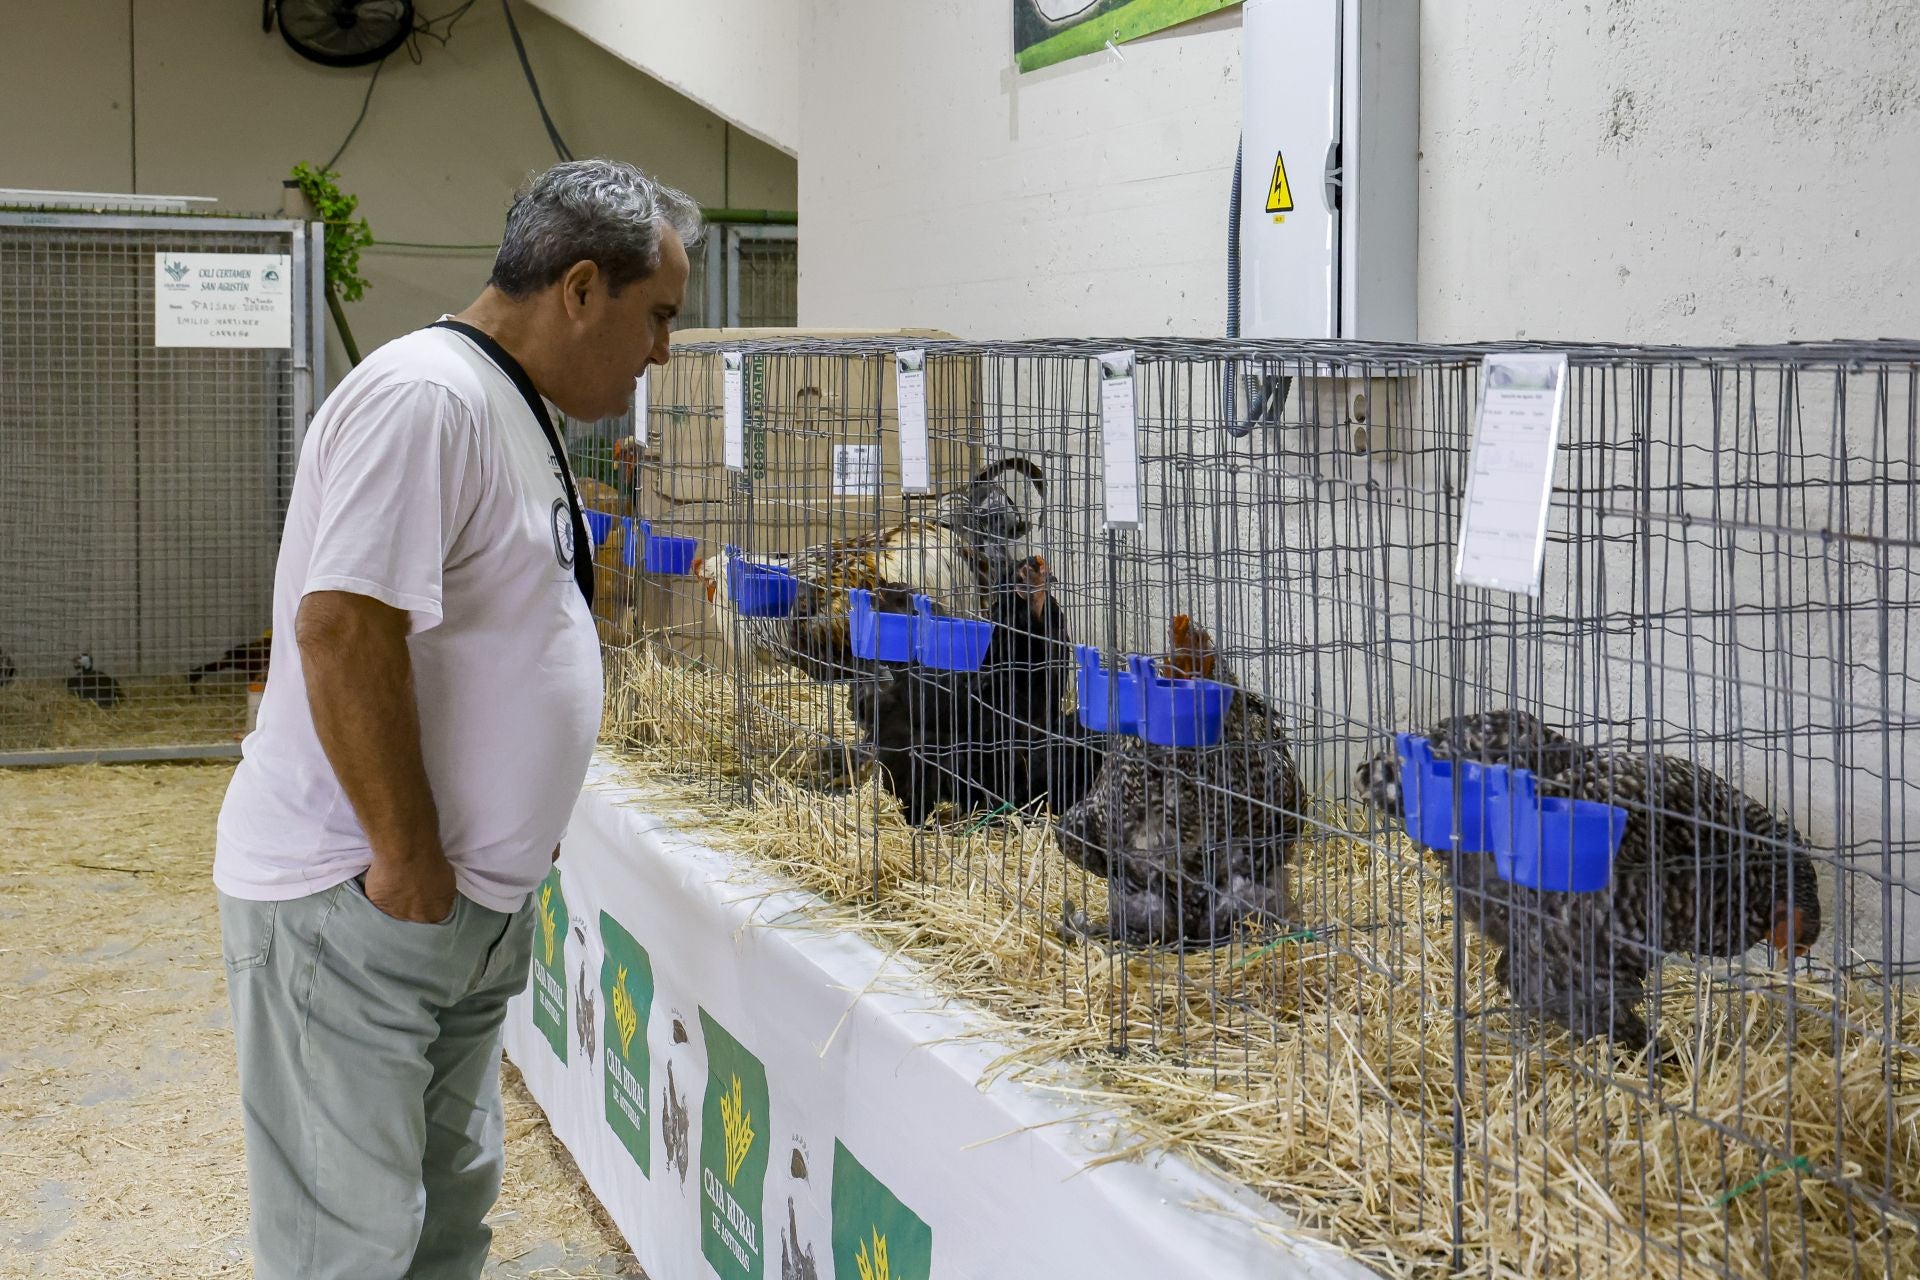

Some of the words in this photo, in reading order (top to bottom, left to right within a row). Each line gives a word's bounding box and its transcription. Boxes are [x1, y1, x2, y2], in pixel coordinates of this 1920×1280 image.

[201, 283, 216, 292] SAN
[215, 268, 252, 278] CERTAMEN
[177, 316, 209, 326] EMILIO
[534, 958, 547, 990] CAJA
[546, 972, 565, 1013] RURAL
[607, 1047, 623, 1086] CAJA
[622, 1065, 647, 1116] RURAL
[612, 1084, 620, 1105] DE
[619, 1092, 641, 1132] ASTURIAS
[704, 1167, 726, 1215] CAJA
[727, 1191, 759, 1256] RURAL
[712, 1211, 721, 1236] DE
[721, 1223, 750, 1273] ASTURIAS
